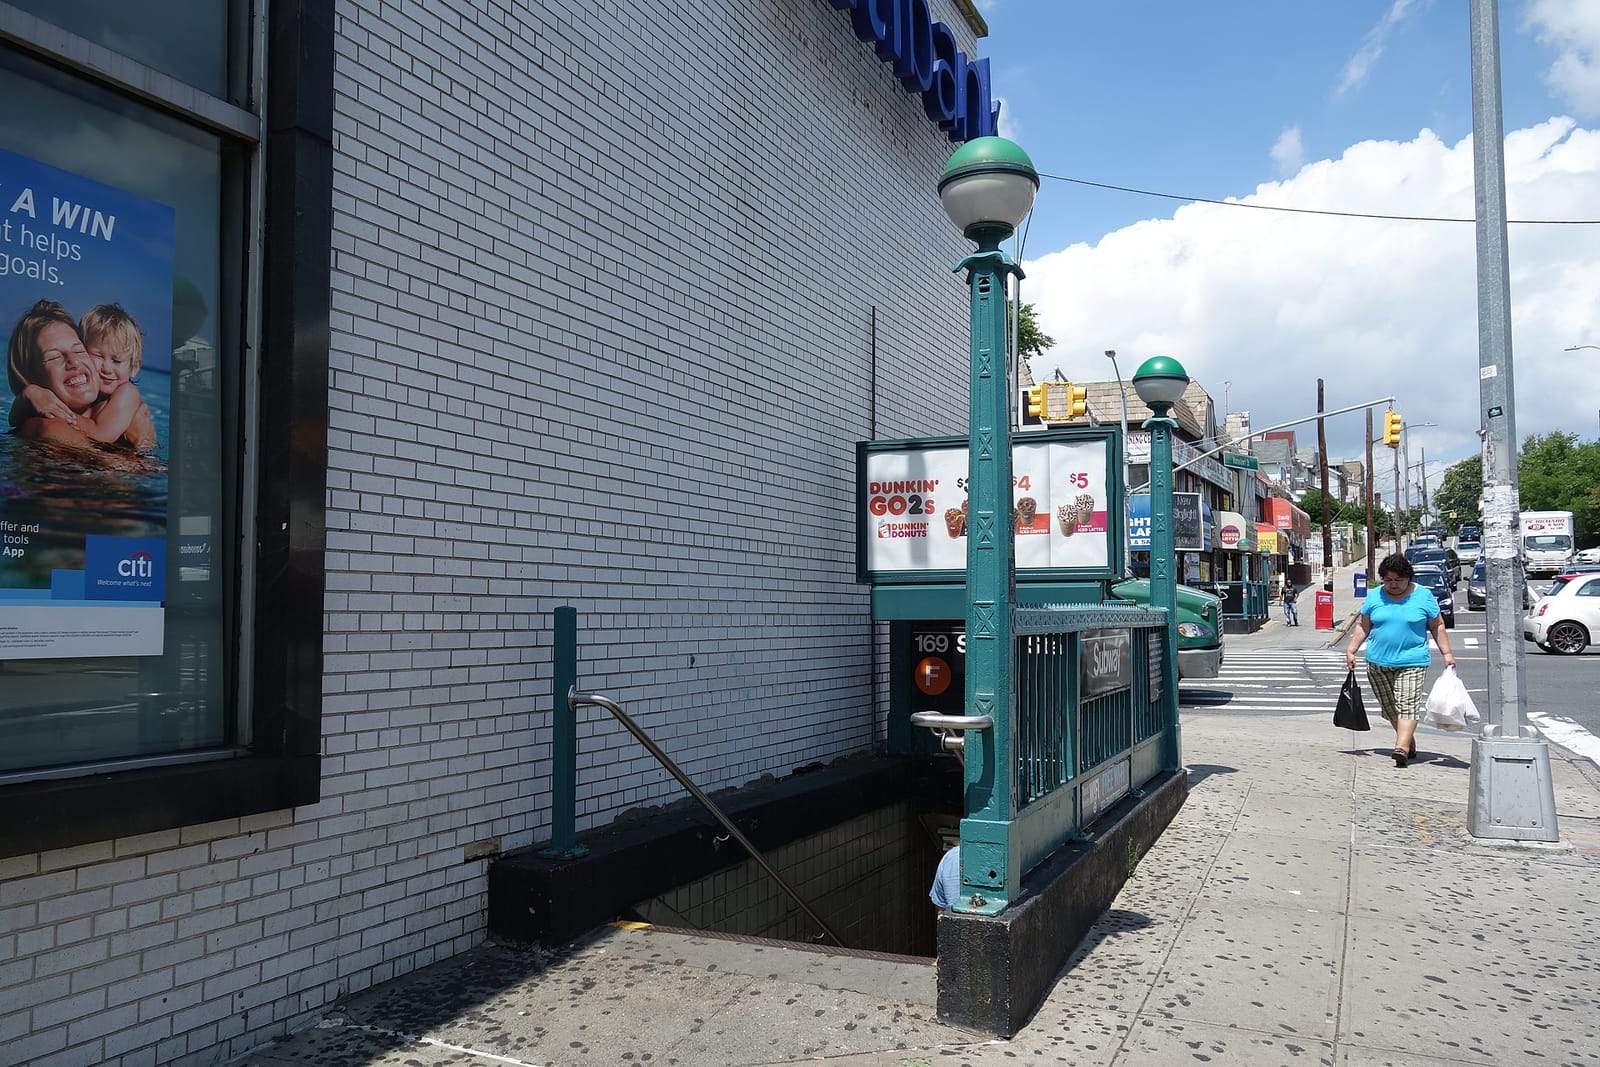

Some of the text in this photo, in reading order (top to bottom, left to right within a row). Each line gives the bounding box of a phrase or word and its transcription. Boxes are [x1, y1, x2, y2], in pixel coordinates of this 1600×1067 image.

[10, 188, 116, 241] A WIN
[0, 219, 81, 261] t helps
[0, 252, 64, 286] goals.
[869, 479, 939, 495] DUNKIN'
[1069, 472, 1089, 489] $5
[20, 523, 39, 533] and
[891, 522, 929, 531] DUNKIN'
[891, 530, 927, 538] DONUTS
[3, 533, 29, 545] tools
[2, 546, 25, 558] App
[117, 555, 153, 578] citi
[914, 634, 966, 654] 169 S
[1093, 641, 1121, 677] Subway
[925, 665, 941, 686] F
